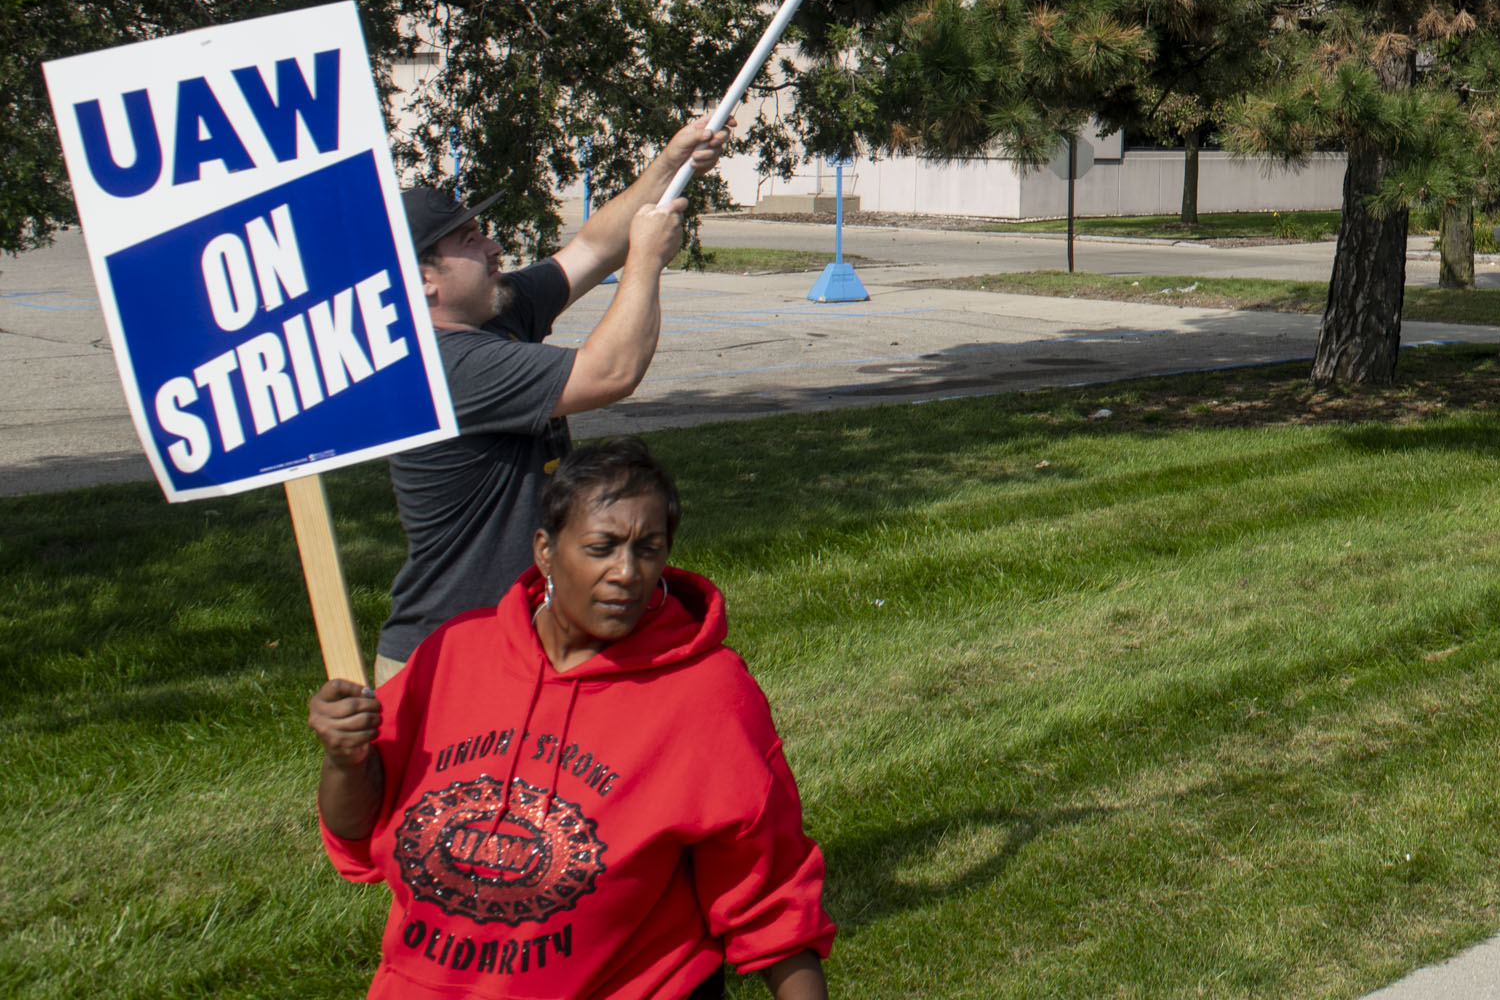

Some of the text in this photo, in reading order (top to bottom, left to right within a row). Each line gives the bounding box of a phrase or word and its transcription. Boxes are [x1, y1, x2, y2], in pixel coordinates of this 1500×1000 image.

[73, 48, 340, 198] UAW
[201, 203, 308, 331] ON
[155, 269, 409, 473] STRIKE
[436, 728, 620, 797] UNION STRONG
[449, 828, 540, 873] UAW
[401, 916, 573, 974] OLIDARITY
